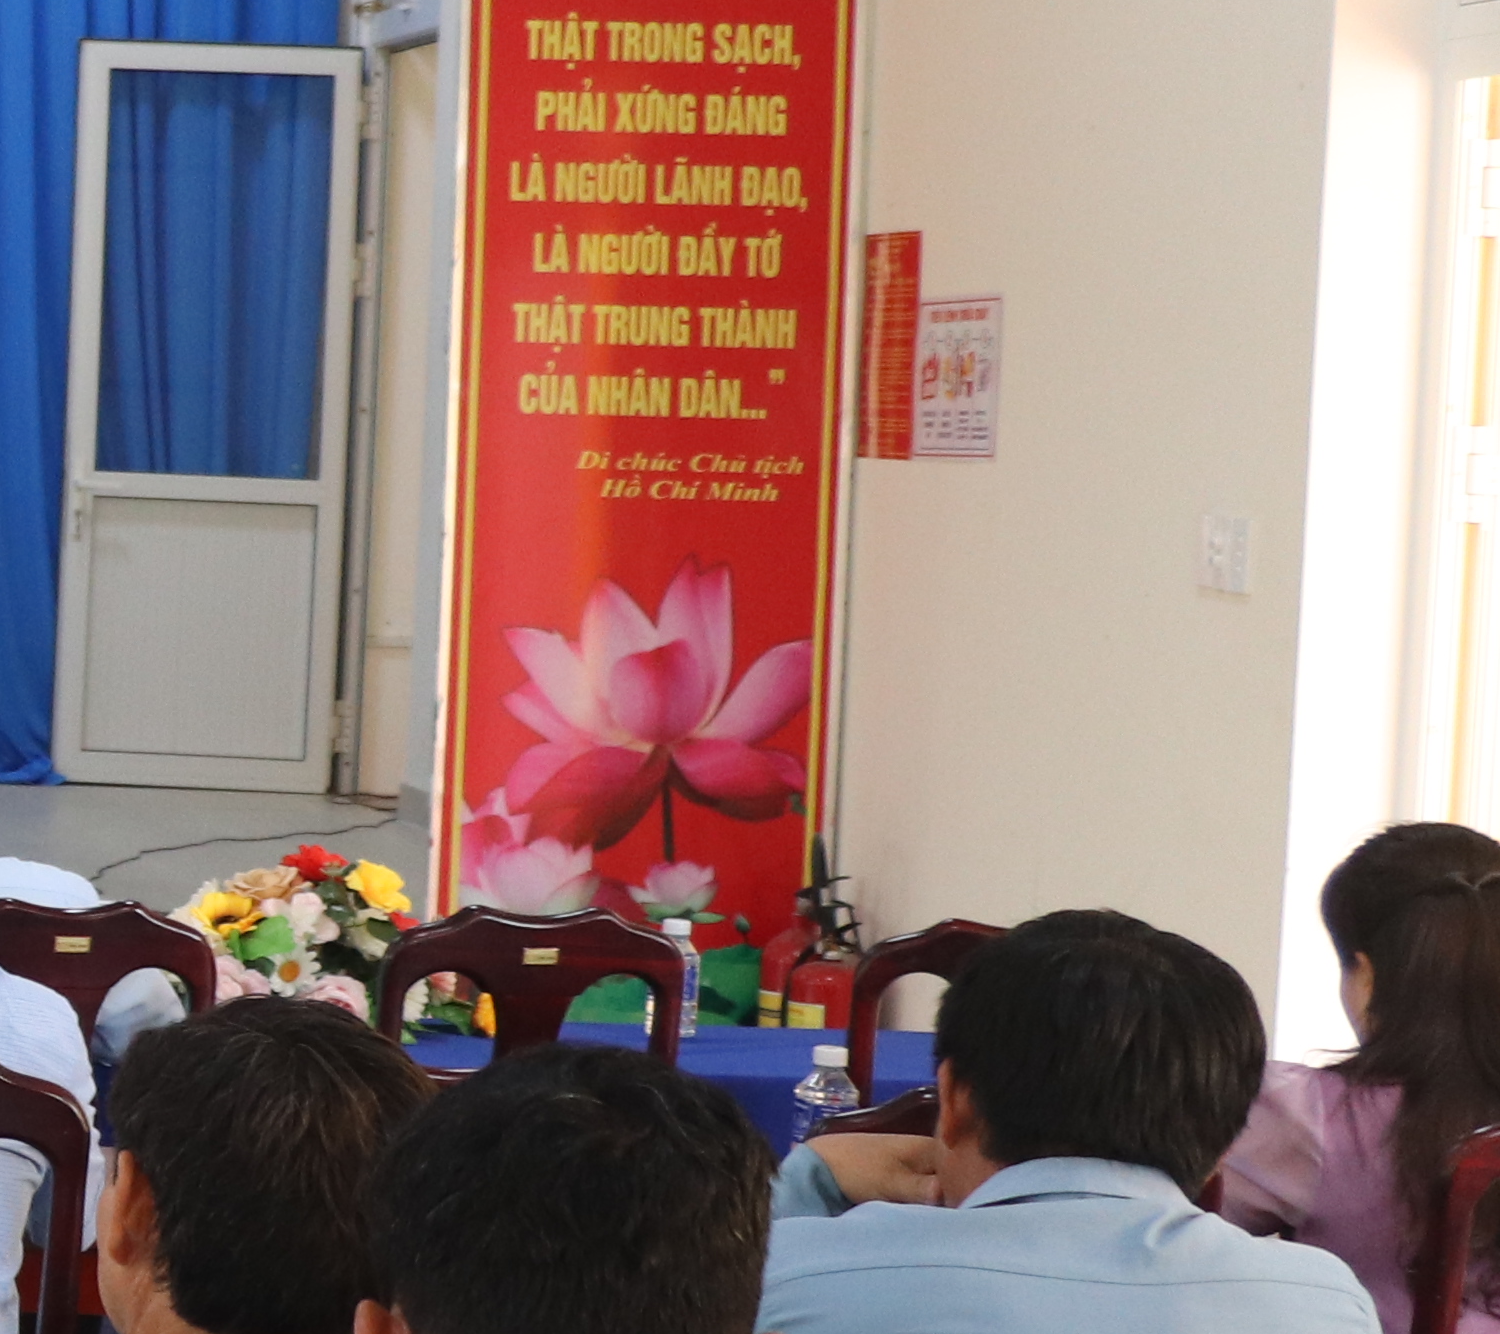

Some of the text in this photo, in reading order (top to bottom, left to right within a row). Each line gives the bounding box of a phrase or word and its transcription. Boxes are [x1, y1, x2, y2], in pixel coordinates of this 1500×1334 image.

[526, 12, 801, 73] THẬT TRONG SẠCH,
[536, 78, 788, 135] PHẢI XỨNG ĐÁNG
[510, 153, 808, 215] LÀ NGƯỜI LÃNH ĐẠO,
[513, 295, 797, 352] THẬT TRUNG THÀNH
[519, 361, 579, 414] CỦA
[585, 368, 671, 416] NHÂN
[576, 450, 804, 478] Di chúc Chủ tịch
[600, 475, 779, 501] Hồ Chí Minh
